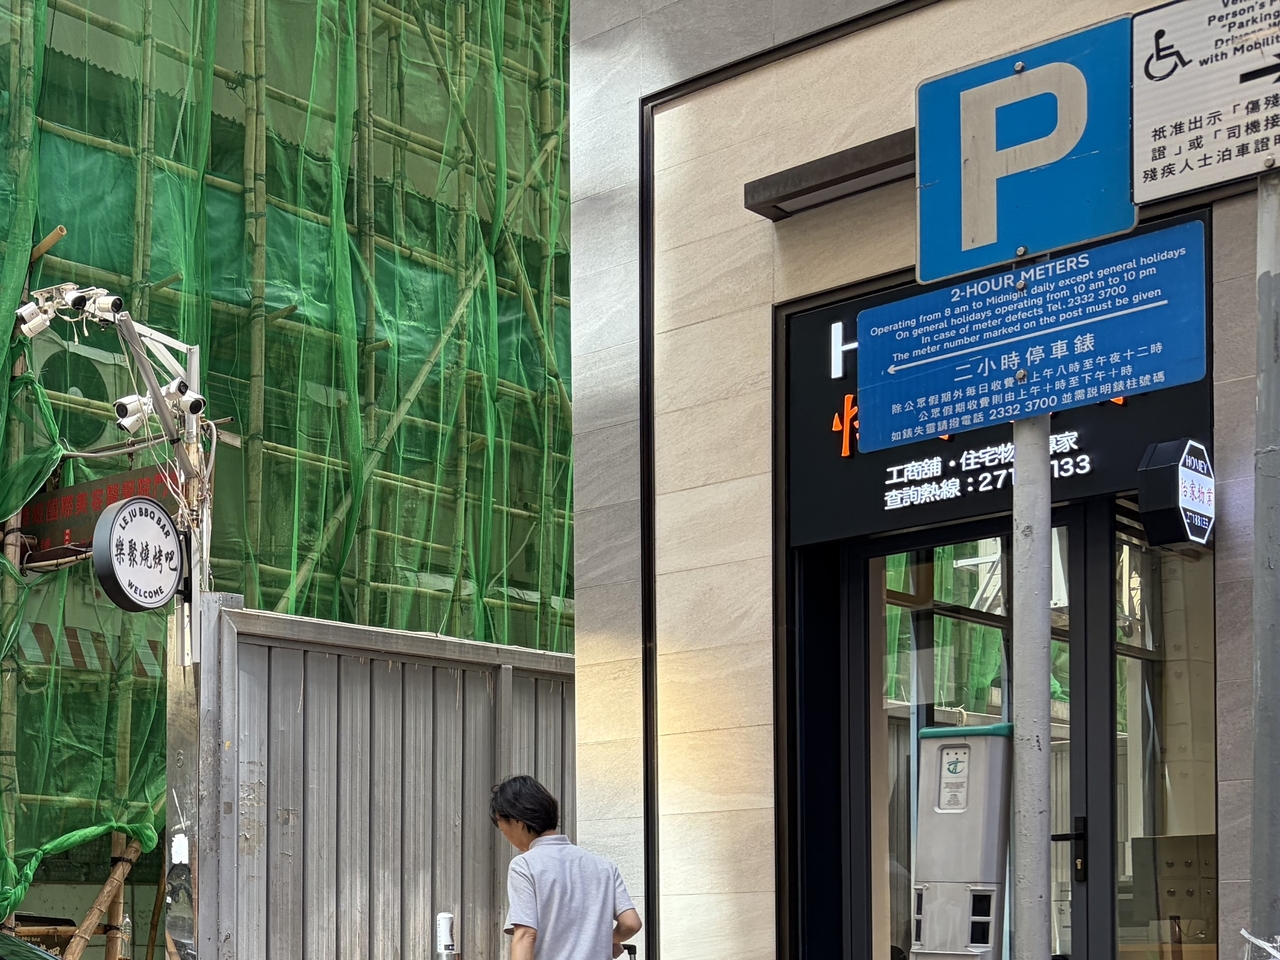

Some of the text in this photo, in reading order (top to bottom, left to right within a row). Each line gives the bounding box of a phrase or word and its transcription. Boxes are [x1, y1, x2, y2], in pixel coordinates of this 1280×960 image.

[1207, 2, 1266, 27] Person's
[1198, 51, 1228, 67] with
[1233, 34, 1280, 56] Mobilit
[960, 61, 1088, 252] P
[870, 247, 1186, 336] Operating from 8 am to Midnight daily except general holidays
[950, 253, 1090, 302] 2-HOUR METERS
[892, 288, 1162, 362] The meter number marked on the post must be given
[895, 267, 1157, 340] On general holidays operating from 10 am to 10 pm
[921, 335, 931, 345] In
[933, 329, 956, 341] case
[959, 324, 971, 335] of
[972, 317, 1002, 332] meter
[1005, 307, 1044, 325] defects
[1067, 293, 1095, 308] 2332
[1098, 285, 1127, 299] 3700
[954, 333, 1095, 381] 二小時停車錶
[989, 404, 1020, 420] 2332
[1024, 396, 1058, 412] 3700
[118, 507, 171, 540] LE JU BBQ BAR
[127, 578, 165, 599] WELCOME
